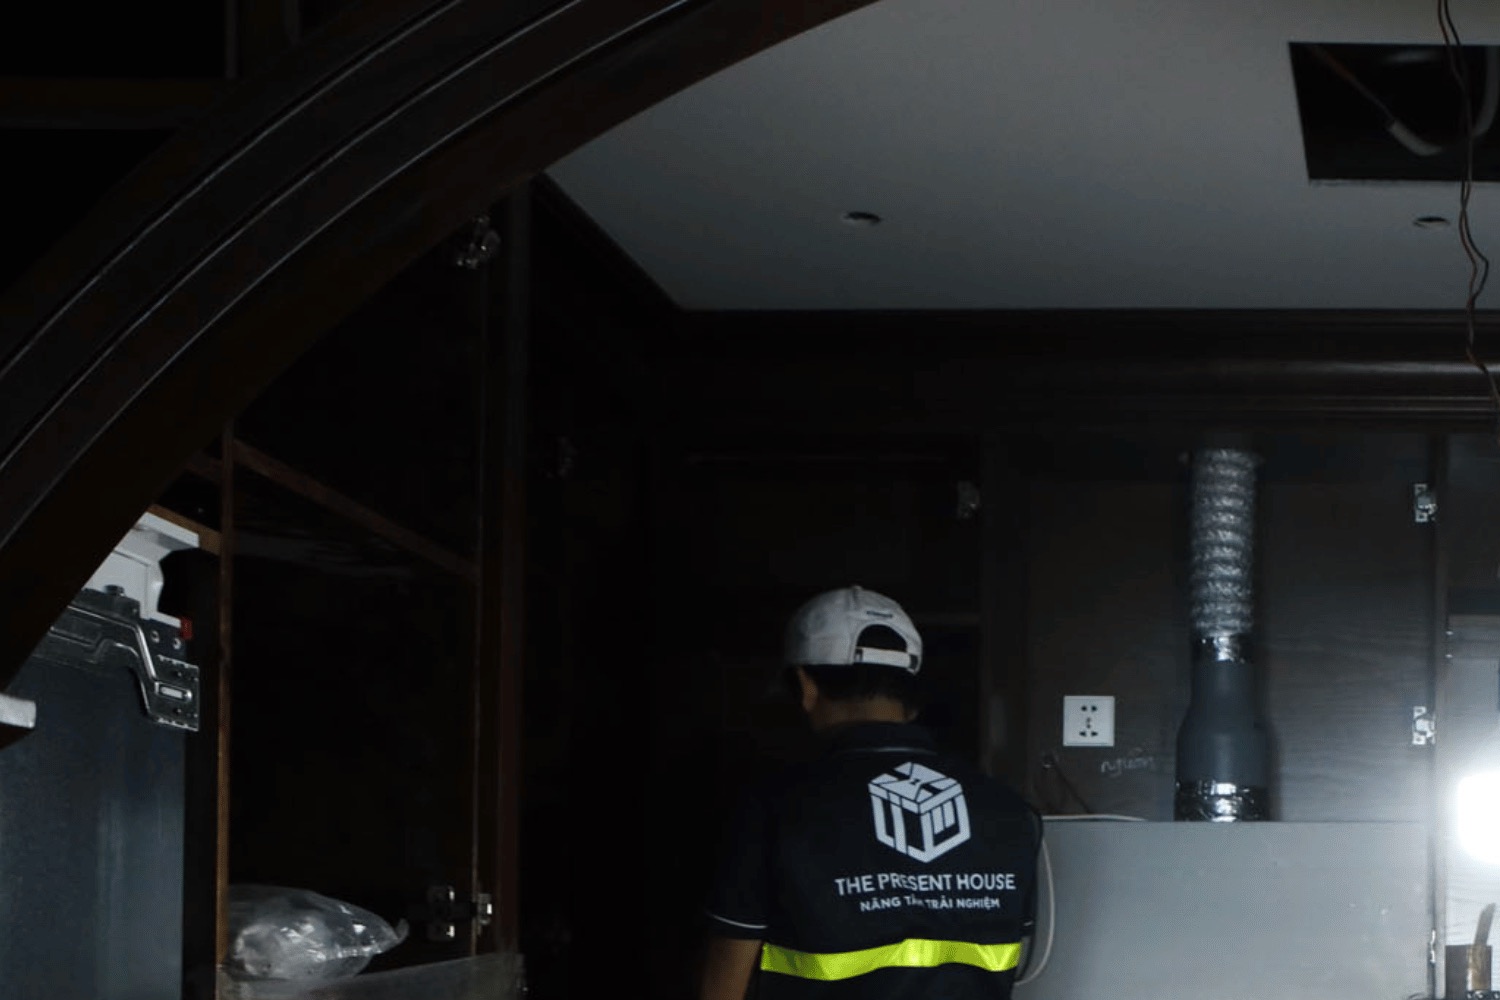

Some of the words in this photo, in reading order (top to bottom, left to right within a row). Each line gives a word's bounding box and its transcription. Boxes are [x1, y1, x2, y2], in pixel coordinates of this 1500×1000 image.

[834, 875, 875, 896] THE
[877, 872, 952, 891] PRESENT
[956, 873, 1016, 890] HOUSE
